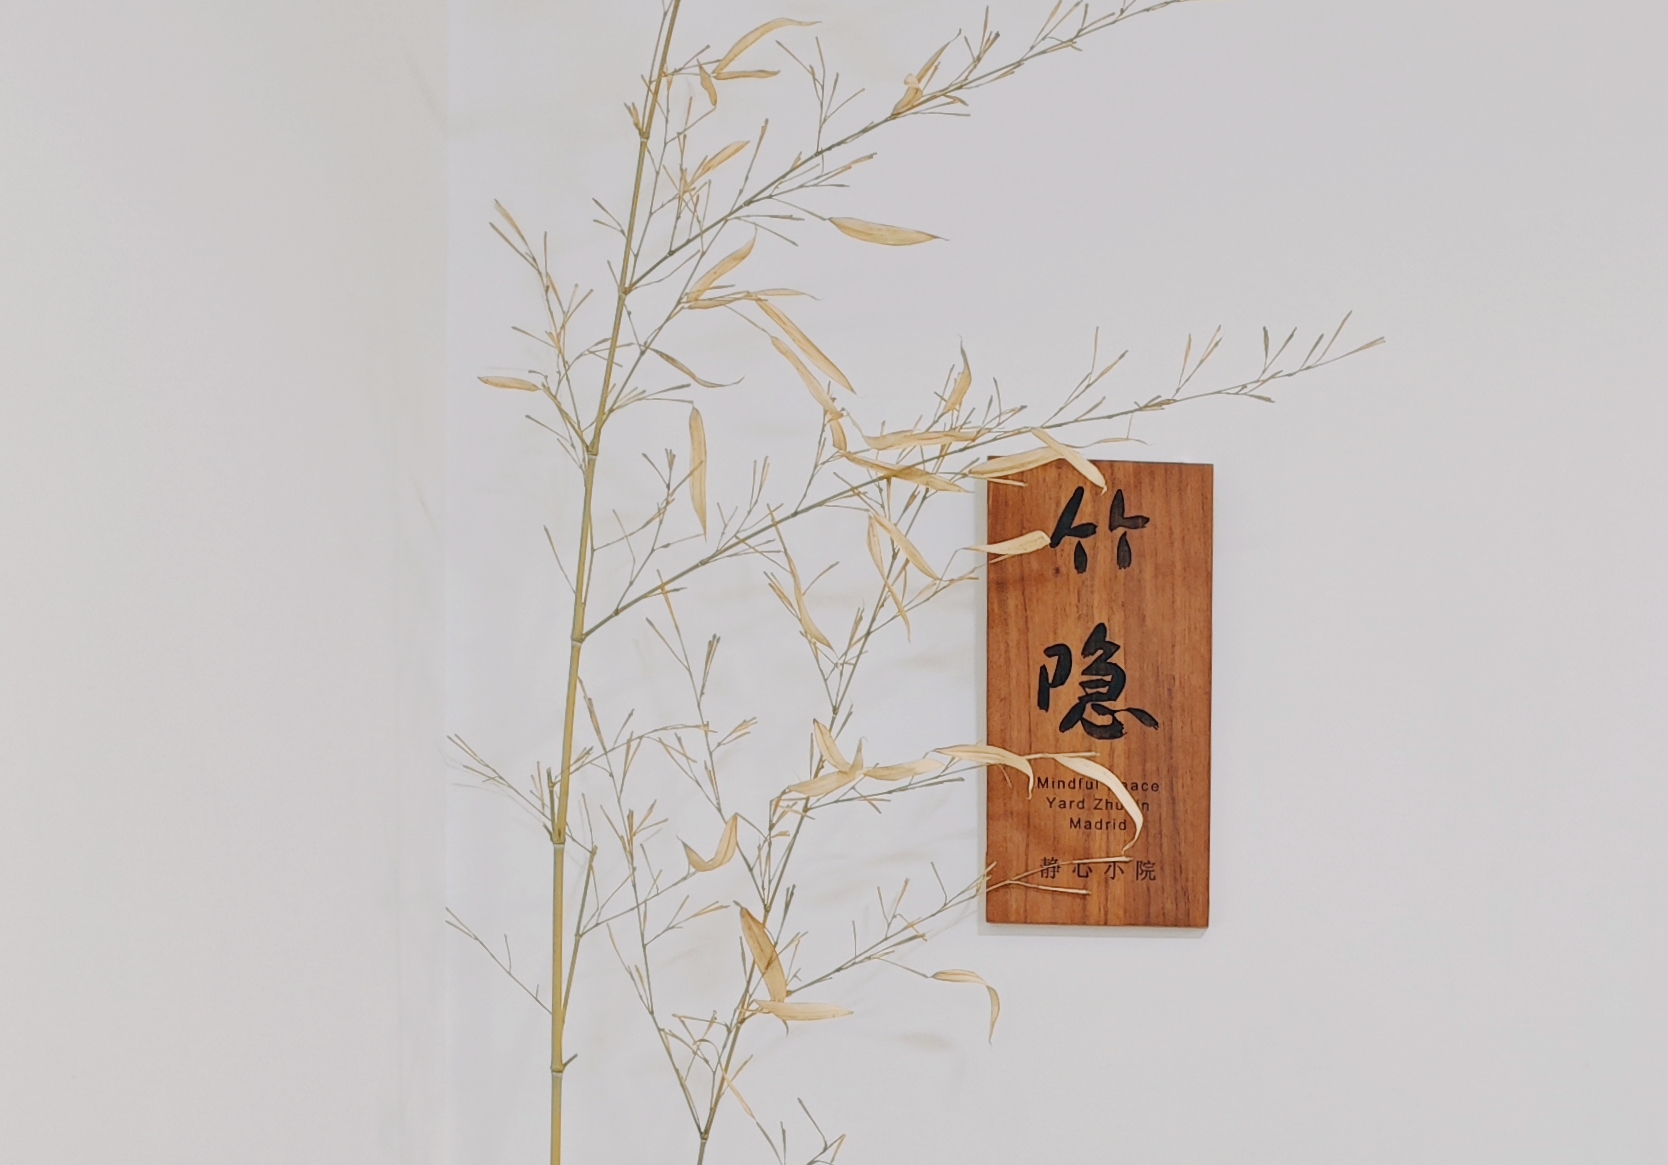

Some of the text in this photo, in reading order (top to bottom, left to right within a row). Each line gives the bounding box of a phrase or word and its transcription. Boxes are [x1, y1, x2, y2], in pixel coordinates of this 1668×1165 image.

[1037, 486, 1160, 740] 竹隐
[1037, 776, 1099, 790] Mindful
[1046, 796, 1085, 810] Yard
[1069, 817, 1127, 831] Madrid
[1040, 856, 1156, 881] 静心小院
